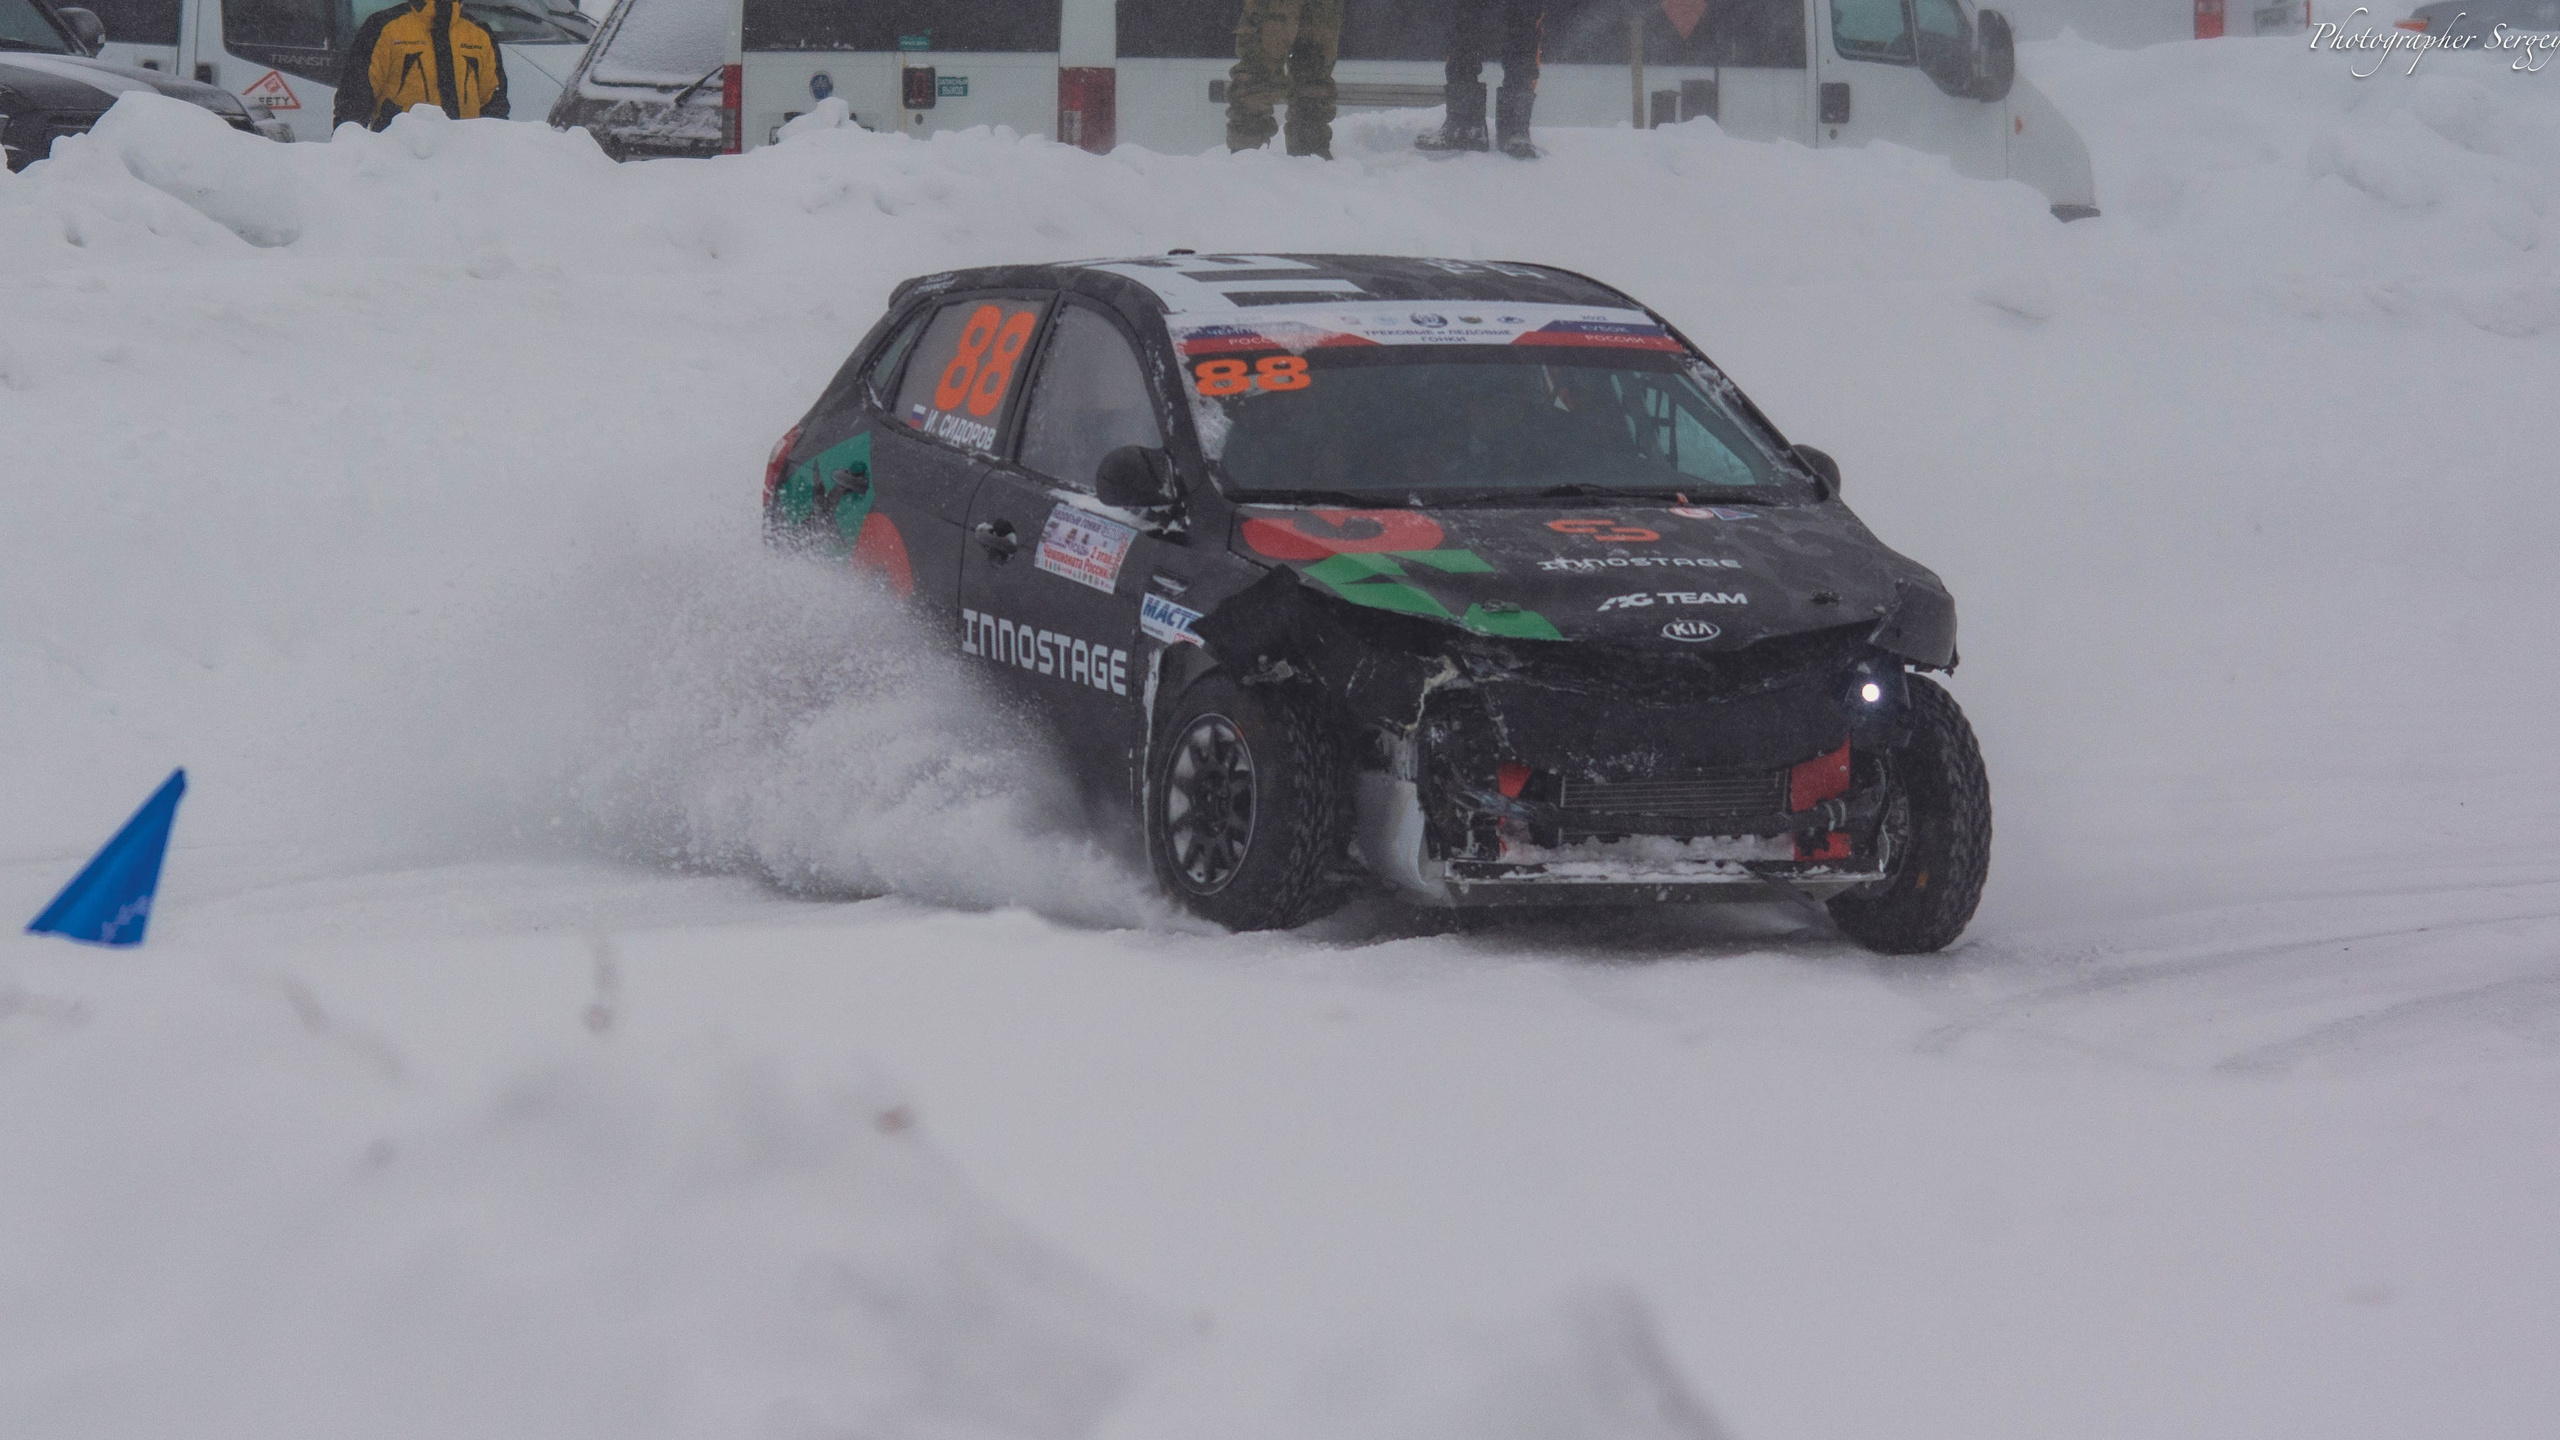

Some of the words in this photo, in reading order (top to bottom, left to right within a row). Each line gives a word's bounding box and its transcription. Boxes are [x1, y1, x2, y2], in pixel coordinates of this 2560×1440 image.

[270, 53, 332, 67] TRANSIT
[942, 86, 964, 95] ВЫХОД
[1363, 329, 1435, 337] ТРЕКОВЫЕ
[1448, 329, 1513, 337] ЛЕДОВЫЕ
[1581, 325, 1629, 333] КУБОК
[1585, 334, 1645, 344] РОССИИ
[935, 304, 1037, 418] 88
[1195, 355, 1311, 396] 88
[924, 409, 940, 434] И.
[938, 414, 997, 450] СИДОРОВ
[1043, 541, 1084, 570] Чемпионата
[1090, 546, 1098, 559] 2
[1537, 556, 1743, 572] INNOSTAGE
[1657, 592, 1748, 605] TEAM
[1672, 621, 1714, 636] KIA
[962, 608, 1127, 697] INNOSTAGE
